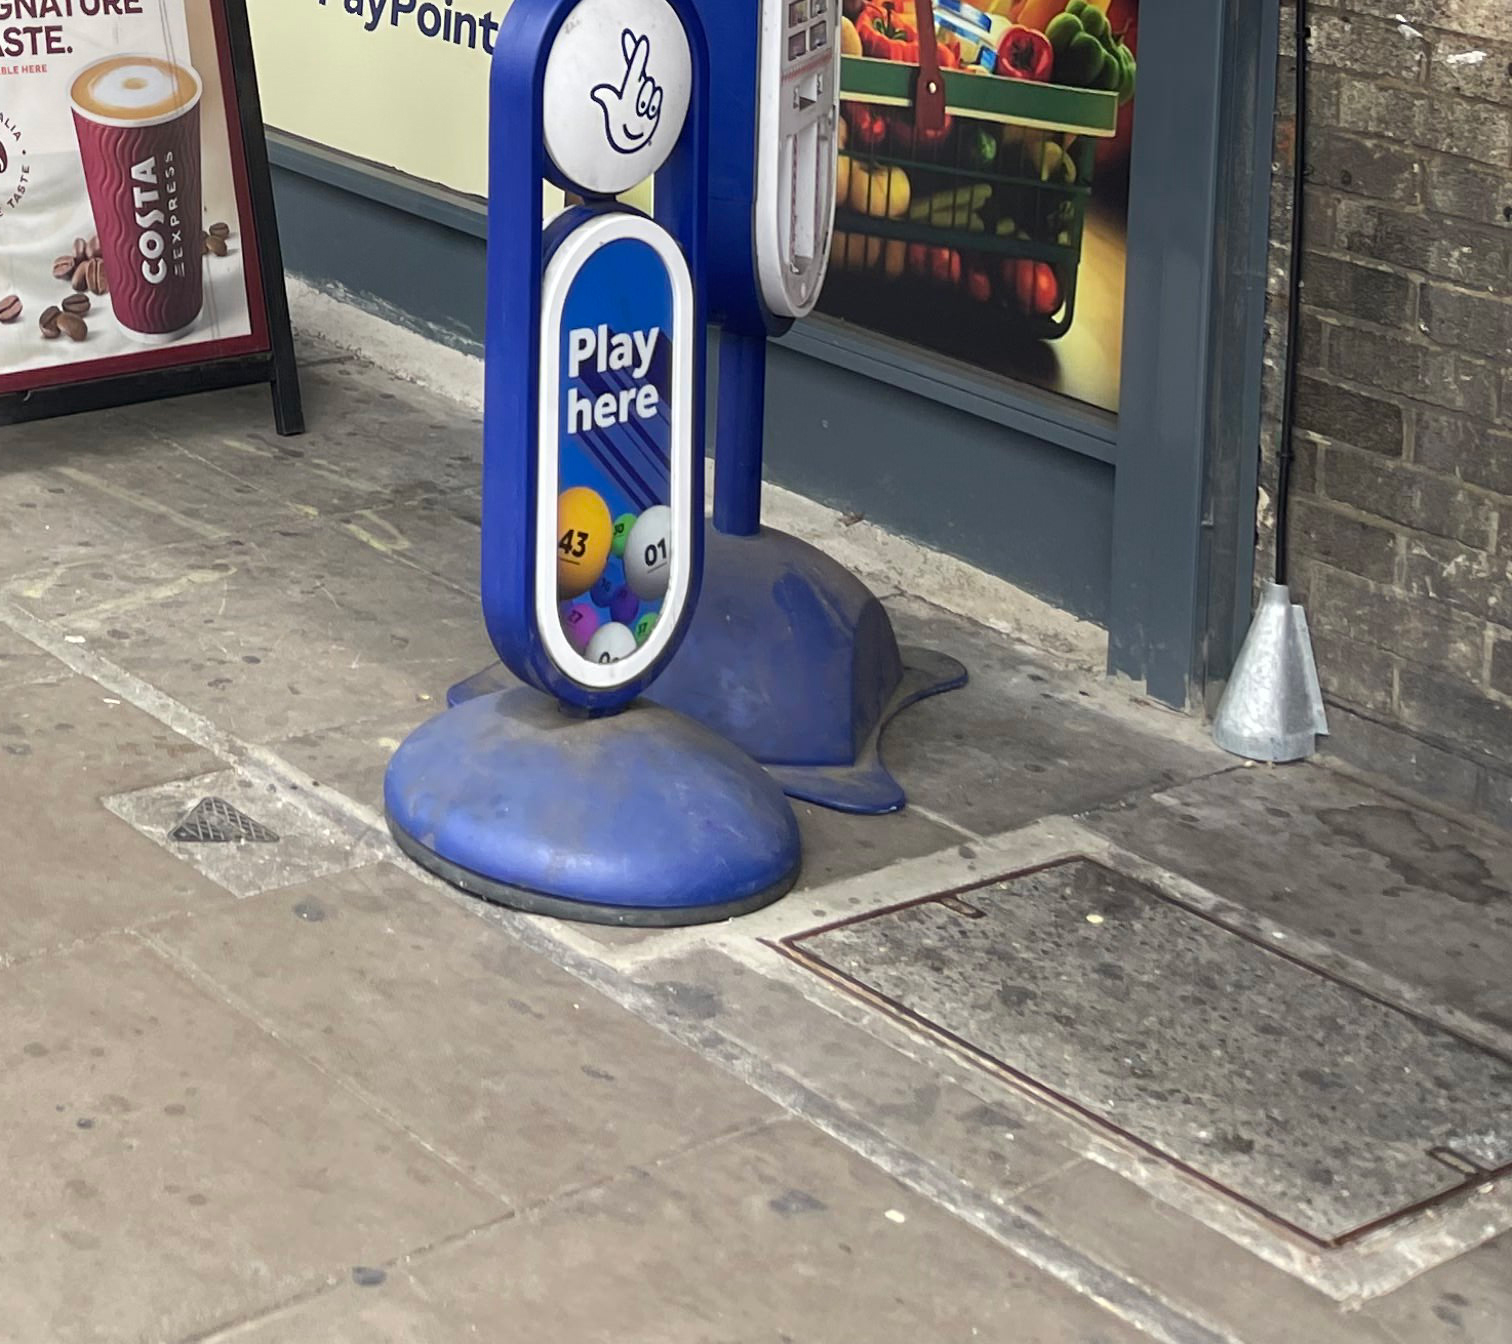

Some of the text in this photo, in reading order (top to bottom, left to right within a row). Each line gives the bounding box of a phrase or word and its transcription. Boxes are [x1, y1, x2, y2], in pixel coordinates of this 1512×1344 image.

[21, 64, 48, 74] HERE
[6, 164, 30, 208] TASTE
[165, 151, 184, 260] EXPRESS
[130, 156, 167, 285] COSTA
[568, 323, 660, 379] Play
[567, 383, 659, 435] here
[558, 528, 589, 558] 43
[644, 538, 668, 566] 01
